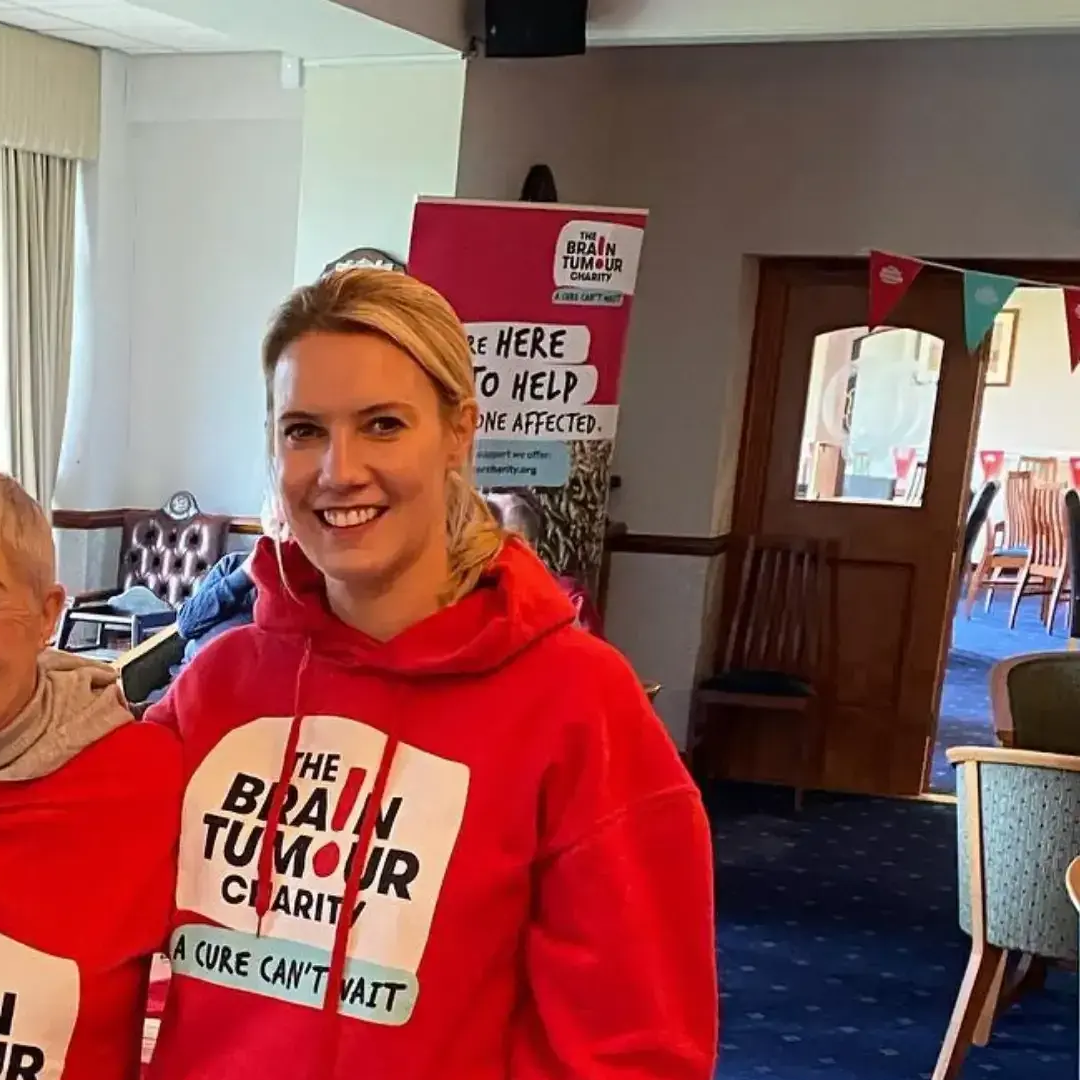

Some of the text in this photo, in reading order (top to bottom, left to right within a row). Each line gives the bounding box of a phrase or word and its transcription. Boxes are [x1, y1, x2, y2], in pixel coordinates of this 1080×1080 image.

[566, 236, 616, 256] BRAIN
[580, 231, 597, 241] THE
[562, 256, 623, 272] TUMOUR
[570, 272, 612, 282] CHARITY
[467, 326, 566, 359] RE HERE
[512, 369, 578, 404] HELP
[512, 411, 602, 435] AFFECTED.
[220, 766, 402, 840] BRAIN
[203, 813, 420, 901] TUMOUR
[173, 934, 186, 960] A
[195, 940, 251, 976] CURE
[260, 955, 330, 994] CAN'T
